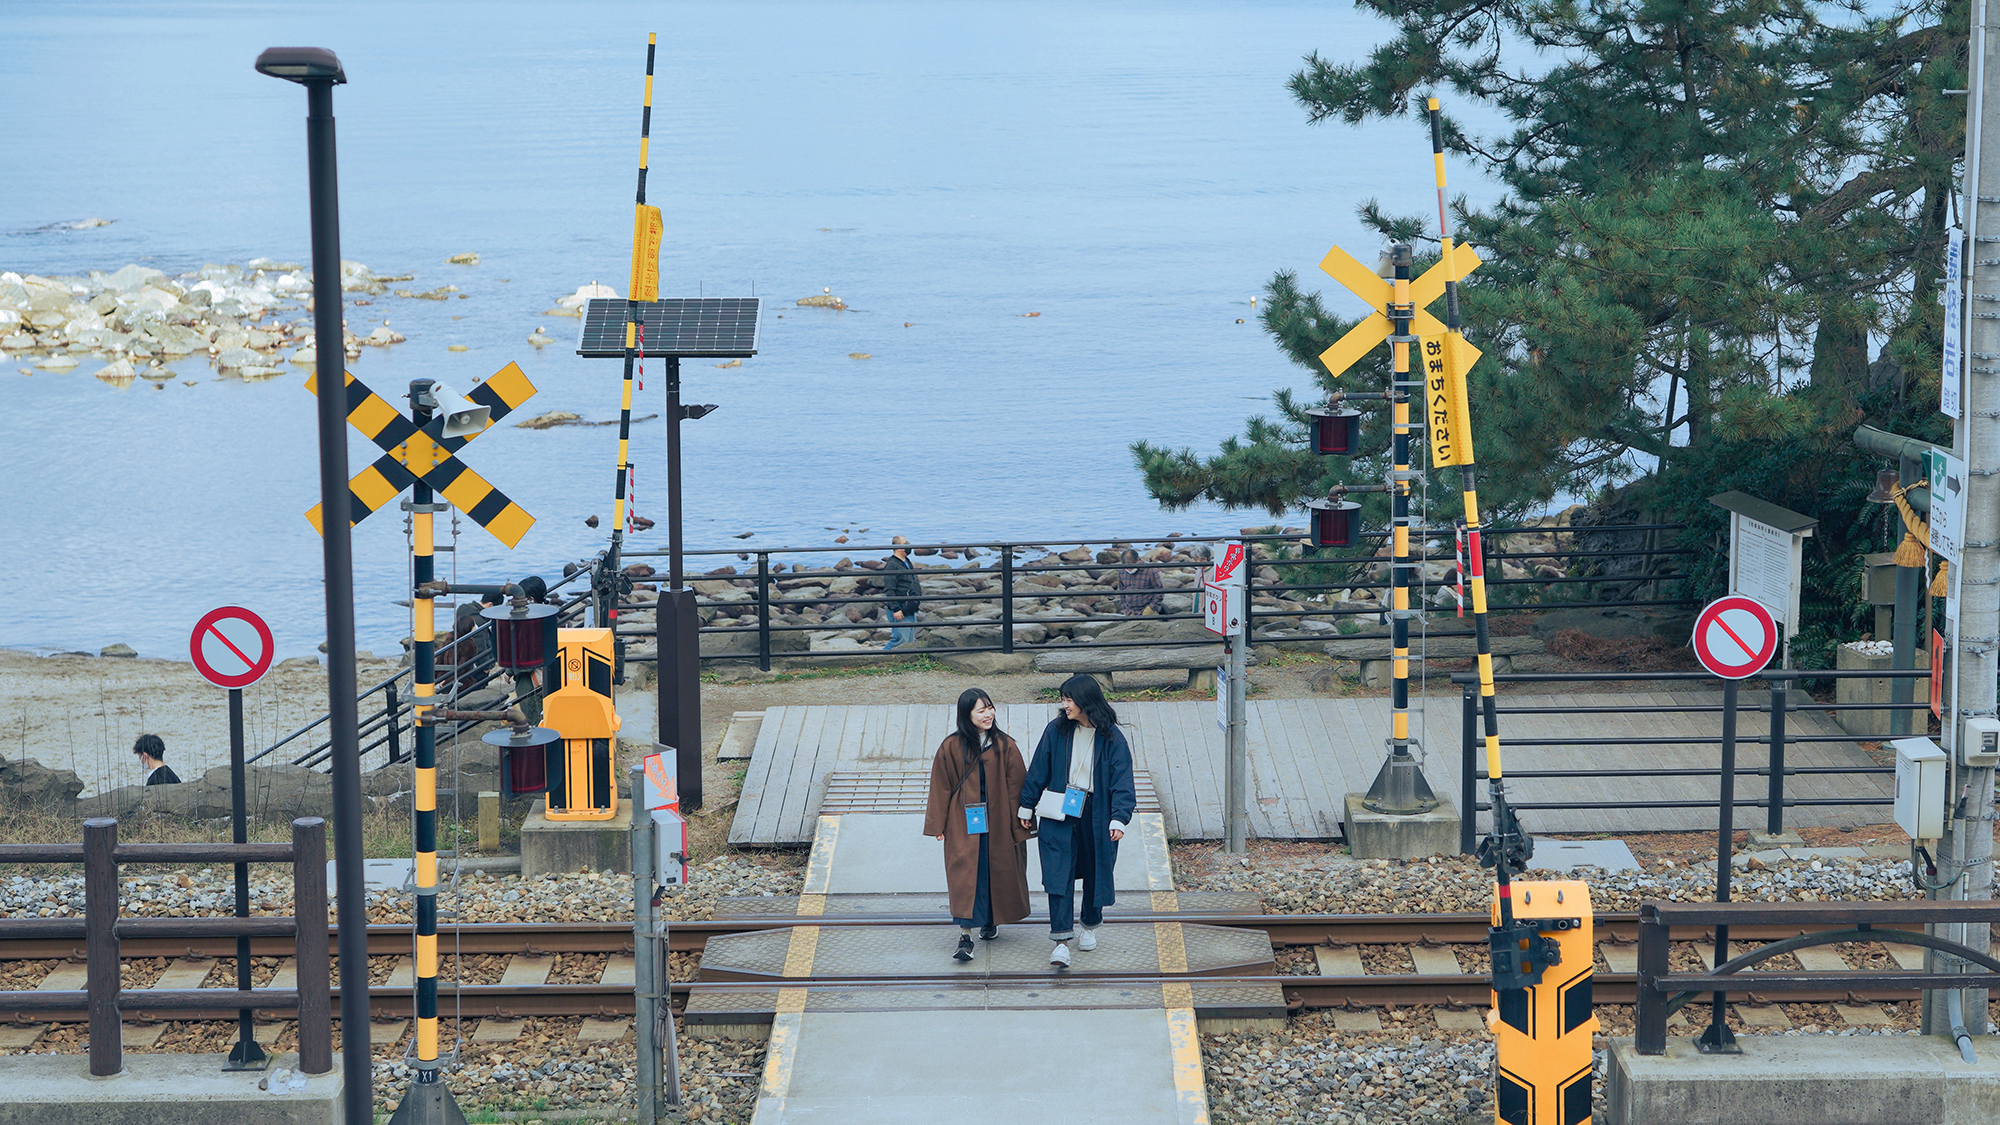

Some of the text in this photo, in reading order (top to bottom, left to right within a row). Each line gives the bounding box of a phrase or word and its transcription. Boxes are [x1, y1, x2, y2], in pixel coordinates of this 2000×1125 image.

[1426, 341, 1451, 461] おまちください
[1218, 547, 1242, 578] 非常ボタン
[646, 757, 671, 795] 非常ボタン
[422, 1071, 432, 1083] X1
